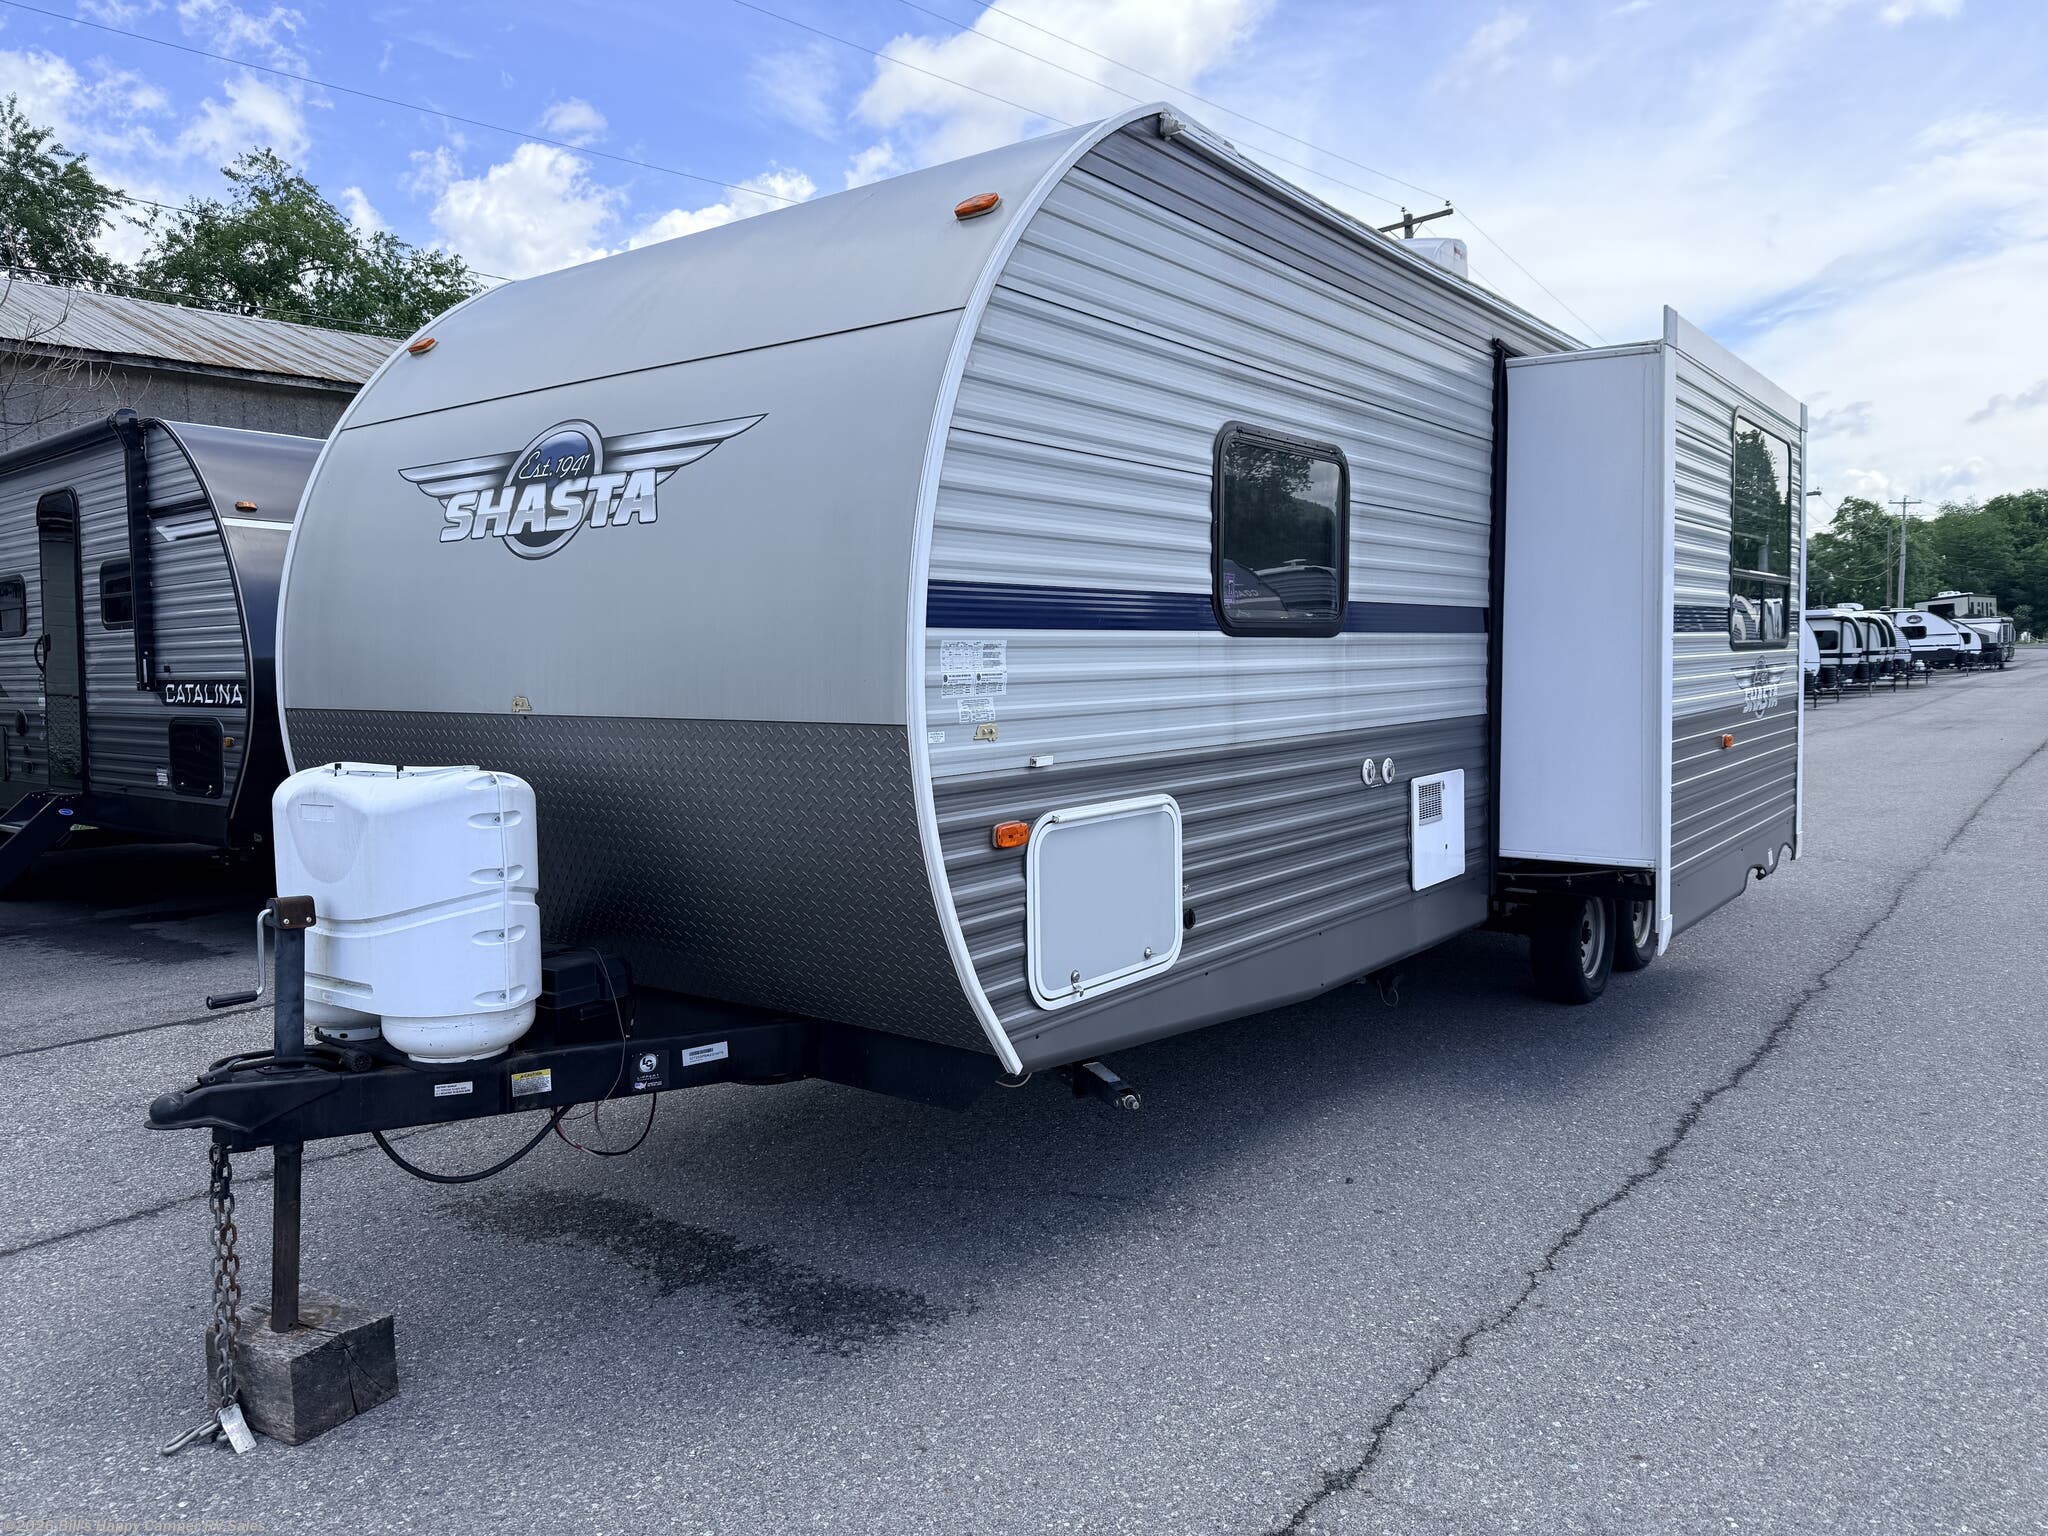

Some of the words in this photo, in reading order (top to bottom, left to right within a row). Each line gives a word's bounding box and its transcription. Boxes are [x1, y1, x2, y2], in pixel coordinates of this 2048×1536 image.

[519, 450, 553, 479] Est.
[555, 454, 590, 478] 1941
[439, 468, 658, 543] SHASTA
[165, 683, 243, 705] CATALINA
